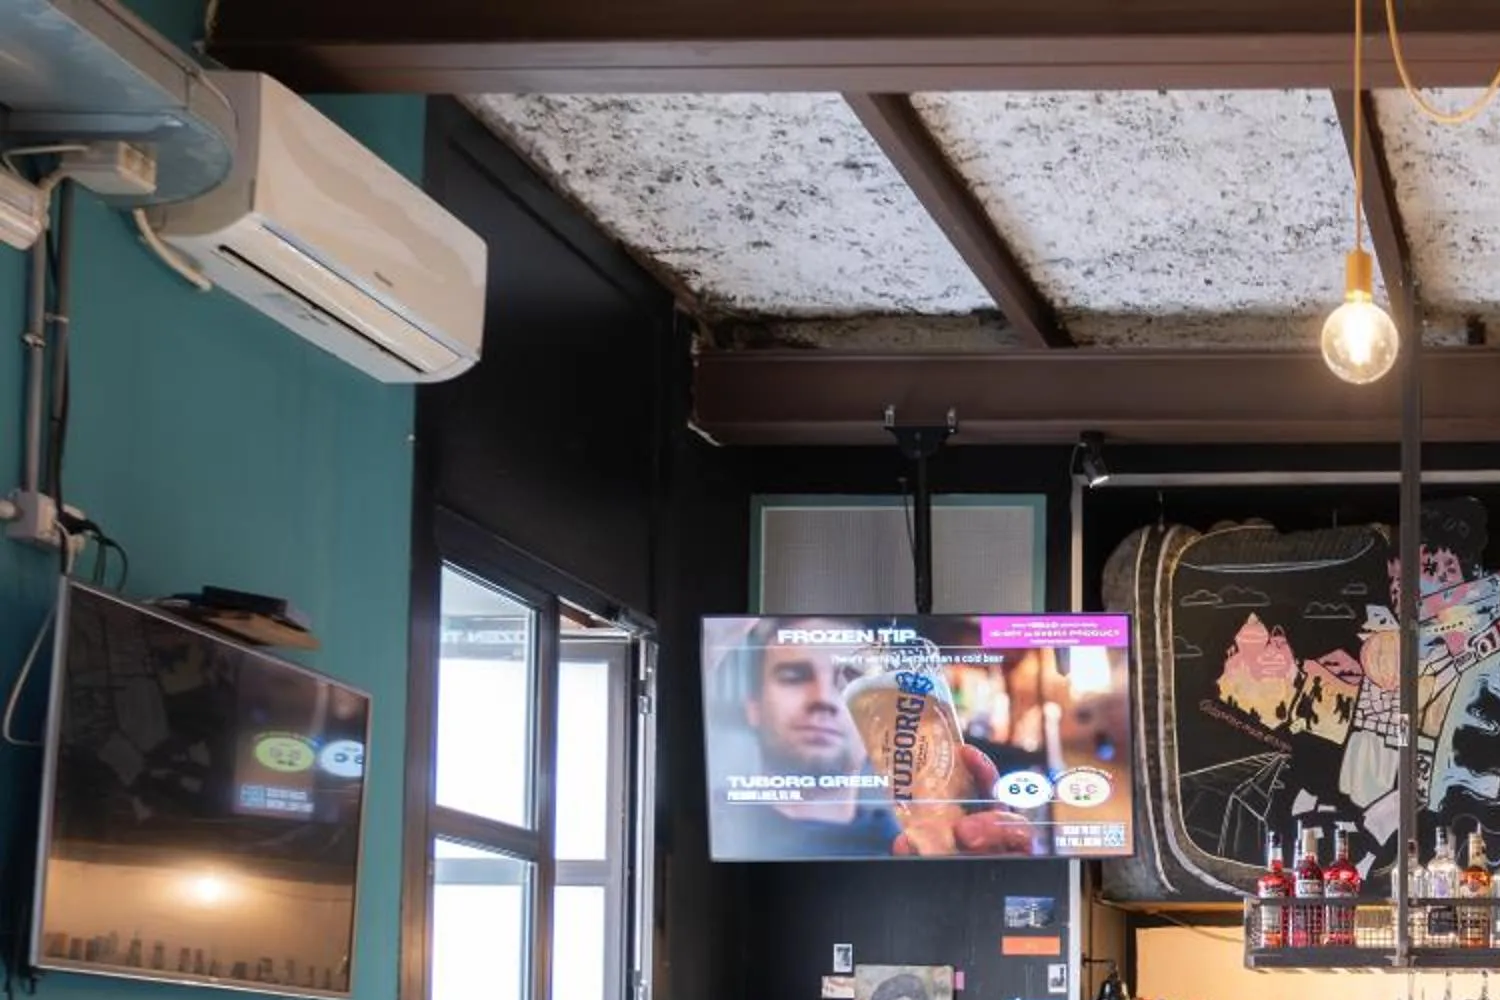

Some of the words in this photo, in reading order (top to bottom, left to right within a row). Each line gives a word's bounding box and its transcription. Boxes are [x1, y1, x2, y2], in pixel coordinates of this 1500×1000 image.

[777, 629, 874, 644] FROZEN
[878, 629, 917, 643] TIP
[727, 775, 816, 788] TUBORG
[819, 775, 889, 788] GREEN
